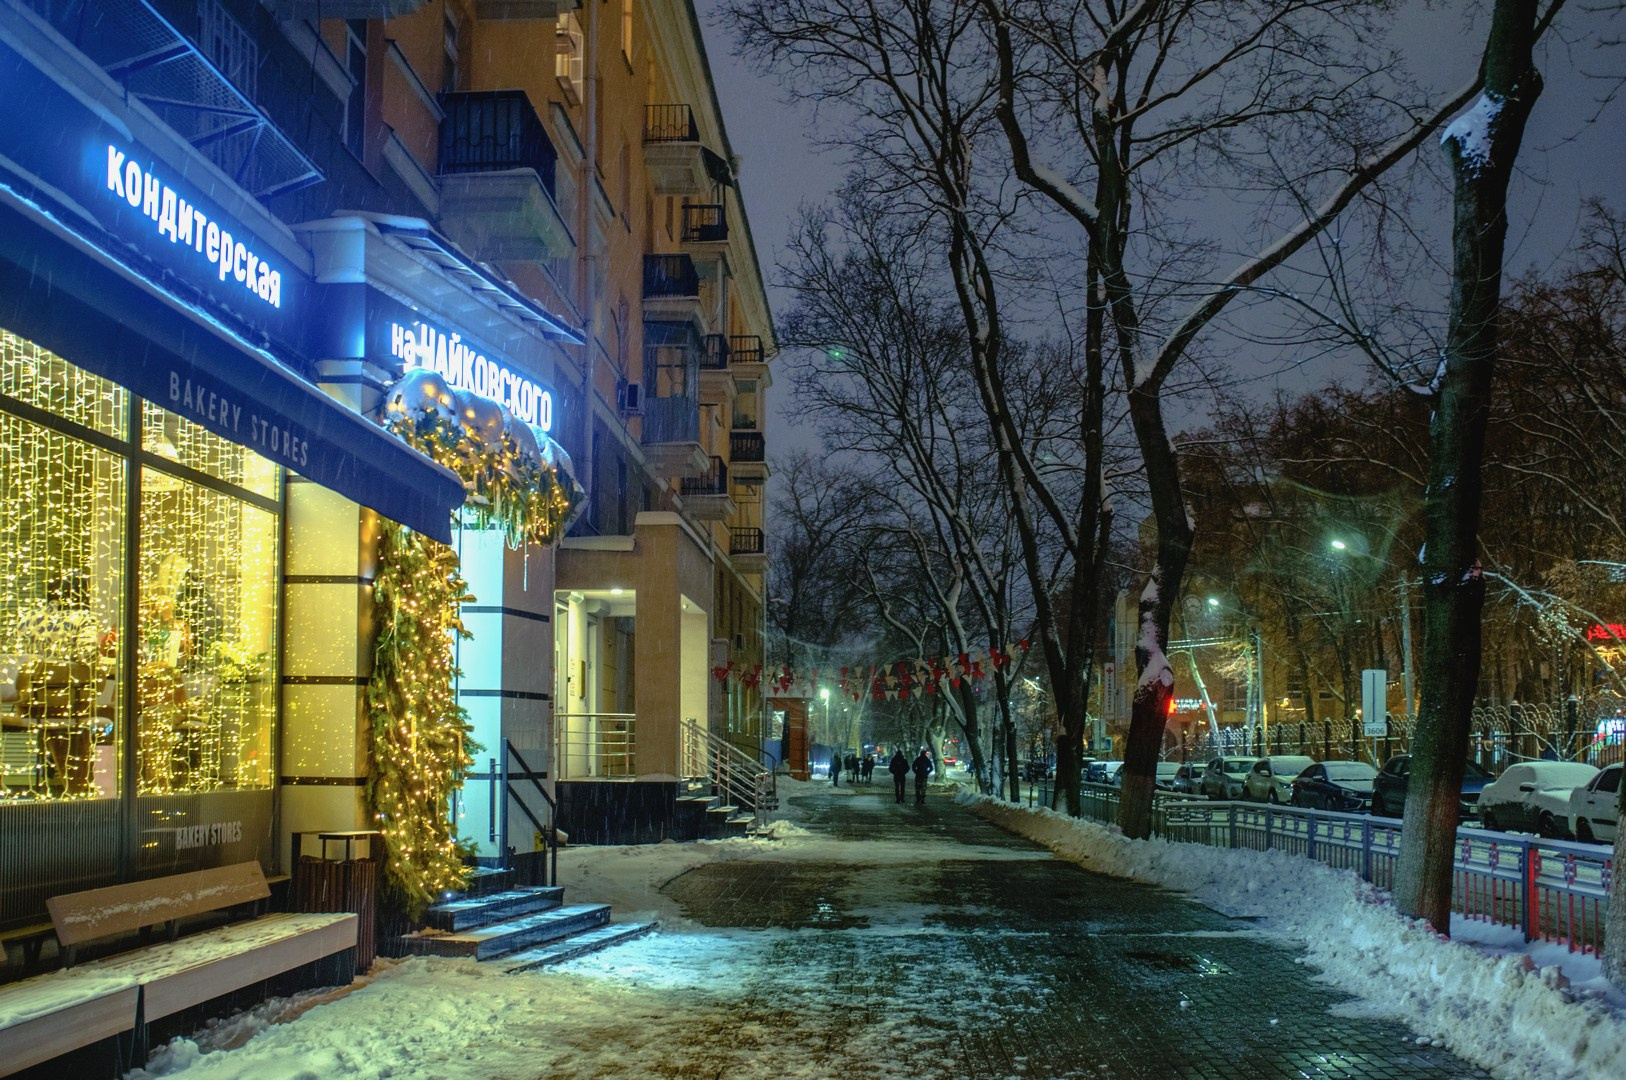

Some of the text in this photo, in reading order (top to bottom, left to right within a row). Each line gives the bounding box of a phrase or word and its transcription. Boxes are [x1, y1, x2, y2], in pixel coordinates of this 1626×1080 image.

[107, 144, 281, 308] кондитерская
[169, 370, 309, 467] BAKERY STORES
[391, 322, 553, 432] на ЧАЙКОВСКОГО
[1367, 727, 1385, 735] 3606
[176, 820, 242, 850] BAKERY STORES
